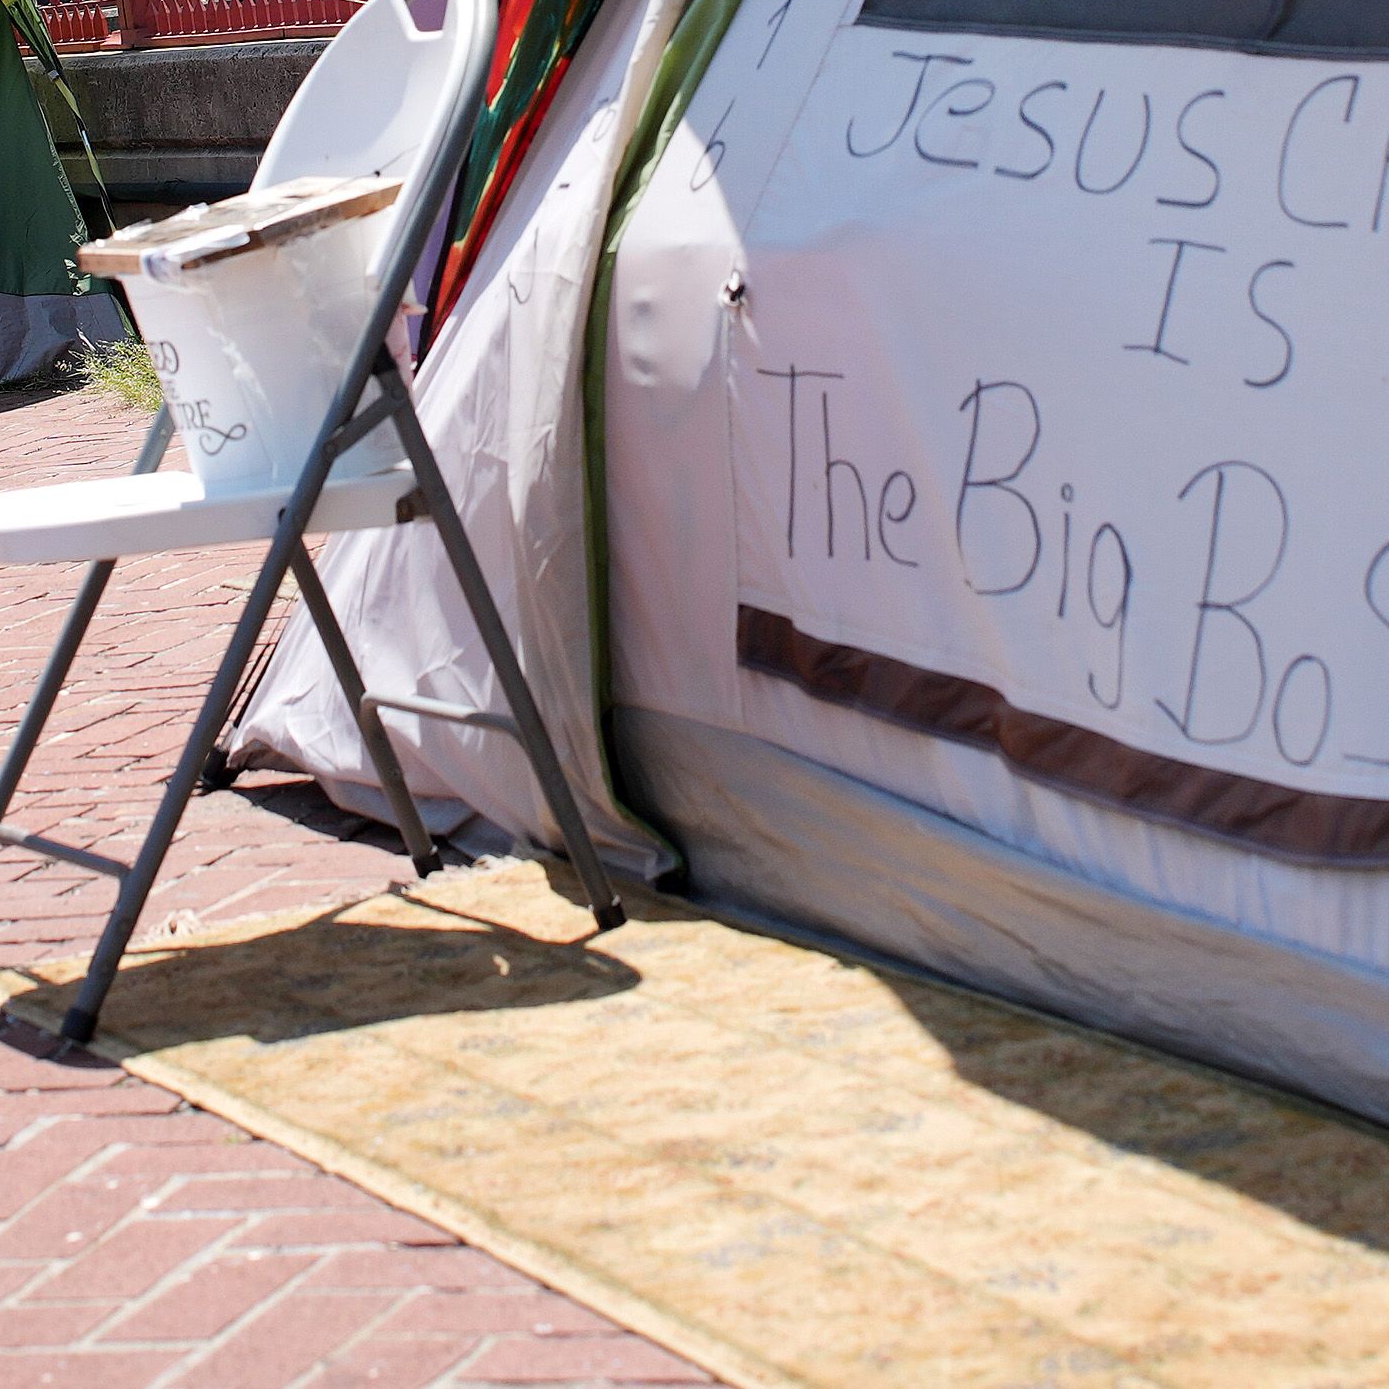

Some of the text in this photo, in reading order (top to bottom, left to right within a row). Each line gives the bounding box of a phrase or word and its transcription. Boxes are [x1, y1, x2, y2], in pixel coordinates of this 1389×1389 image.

[1122, 237, 1296, 389] IS
[757, 363, 920, 568] The
[954, 379, 1134, 712] Big
